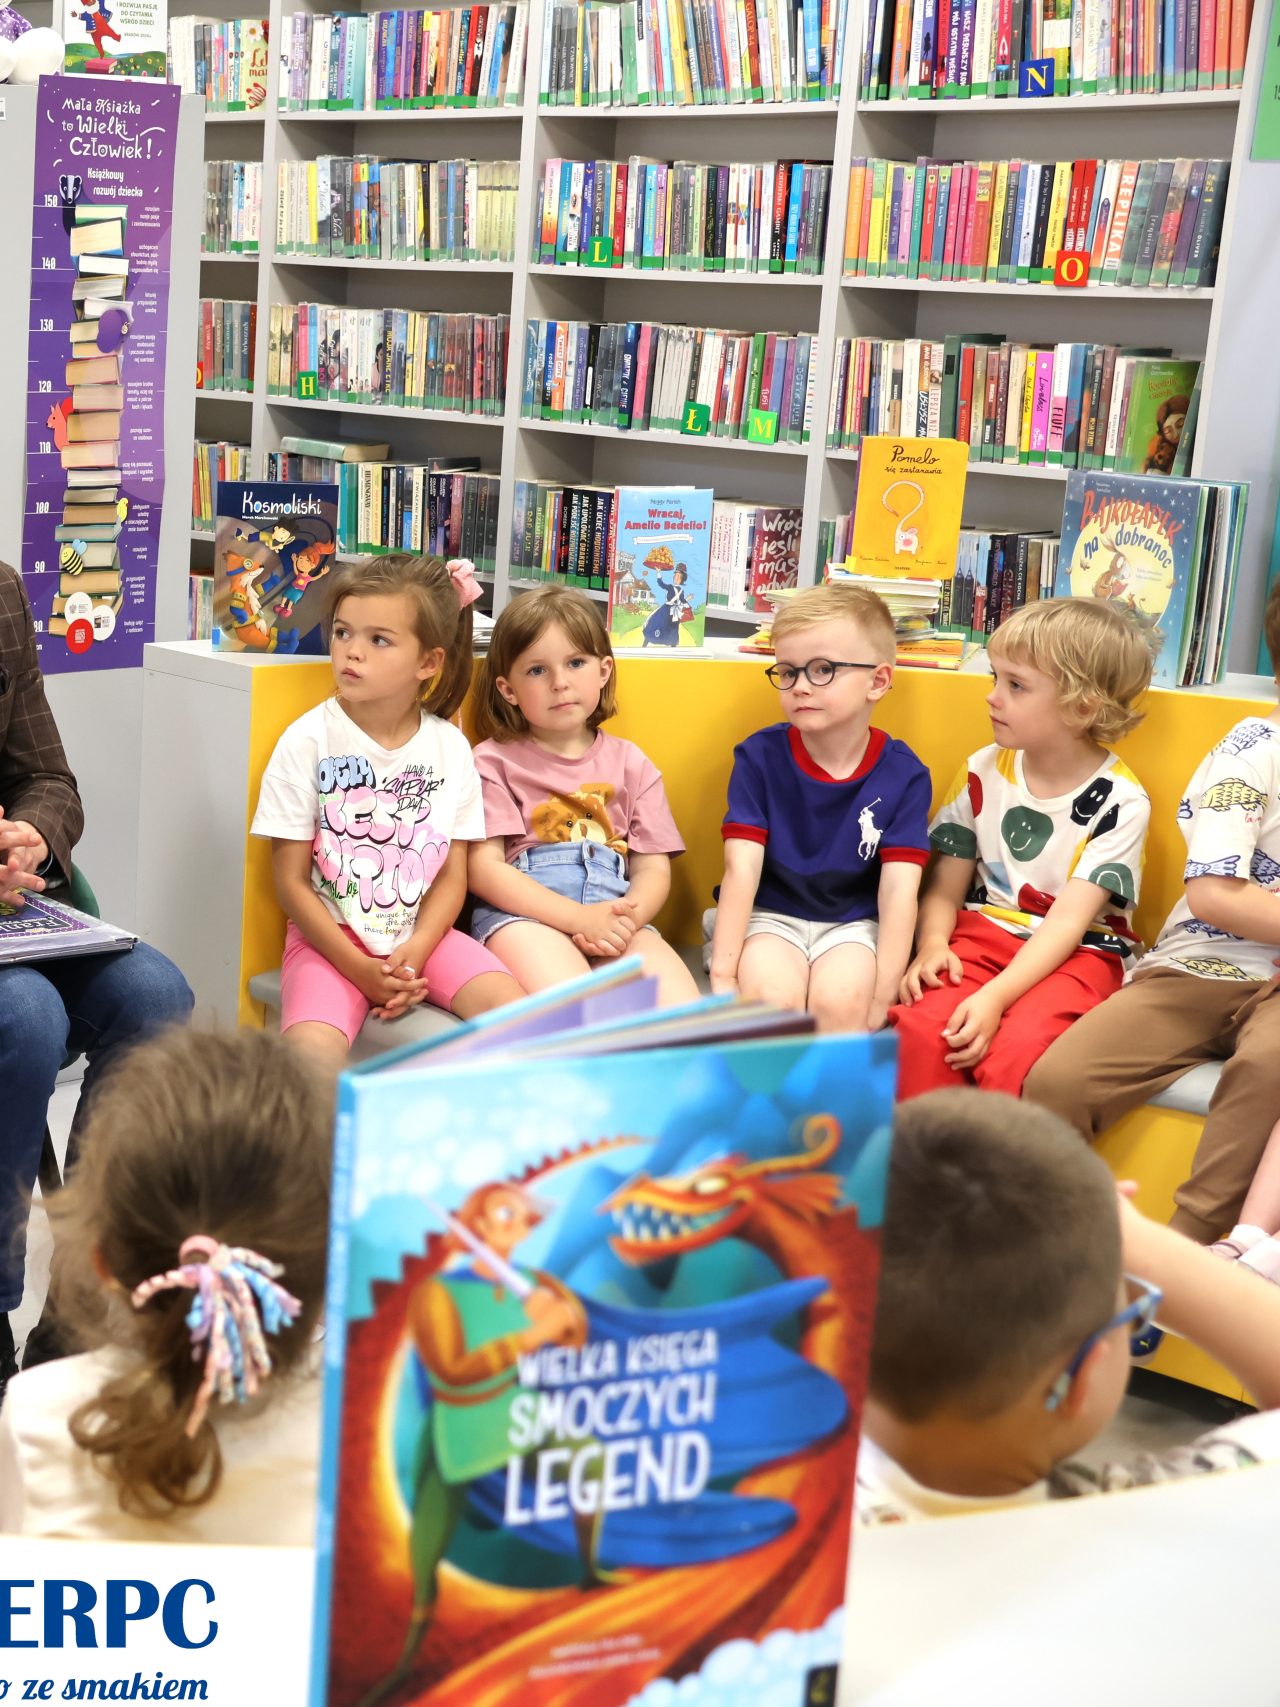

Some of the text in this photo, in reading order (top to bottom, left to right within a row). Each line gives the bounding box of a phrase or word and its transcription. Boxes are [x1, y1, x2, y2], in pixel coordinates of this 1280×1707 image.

[139, 18, 155, 26] DZIECI
[1025, 66, 1049, 92] N
[62, 98, 141, 115] Mała Książka
[62, 114, 133, 139] to Wielki
[87, 167, 124, 183] Książkowy
[44, 194, 58, 207] 150
[93, 185, 143, 198] rozwój dziecka
[774, 164, 786, 235] ZŁODZIEJSKI GAMBIT
[1107, 174, 1135, 253] REPLIKA
[42, 257, 56, 269] 140
[593, 241, 608, 263] L
[1060, 258, 1084, 282] O
[40, 319, 54, 331] 130
[386, 331, 394, 351] MOJA
[38, 380, 52, 392] 120
[300, 377, 316, 396] H
[1036, 376, 1049, 412] Loveless
[929, 388, 939, 416] LEPSZA
[685, 408, 702, 432] Ł
[751, 416, 772, 438] M
[1050, 407, 1064, 439] FLUFF
[39, 441, 51, 453] 110
[891, 445, 940, 465] Pomelo
[884, 466, 943, 475] się zastanawia
[364, 470, 372, 508] HEMINGWAY
[35, 502, 50, 513] 100
[242, 490, 322, 515] Kosmoliski
[624, 518, 707, 531] Amelio Bedelio!
[648, 508, 686, 521] Wracaj,
[533, 507, 543, 557] BEZIMIENNA
[592, 497, 604, 574] JAK UCIEC HOUDINIEMU
[1083, 523, 1172, 569] na dobranoc
[34, 561, 46, 573] 90
[519, 1328, 718, 1387] WIELKA KSIĘGA
[508, 1373, 717, 1446] SMOCZYCH
[504, 1431, 710, 1526] LEGEND
